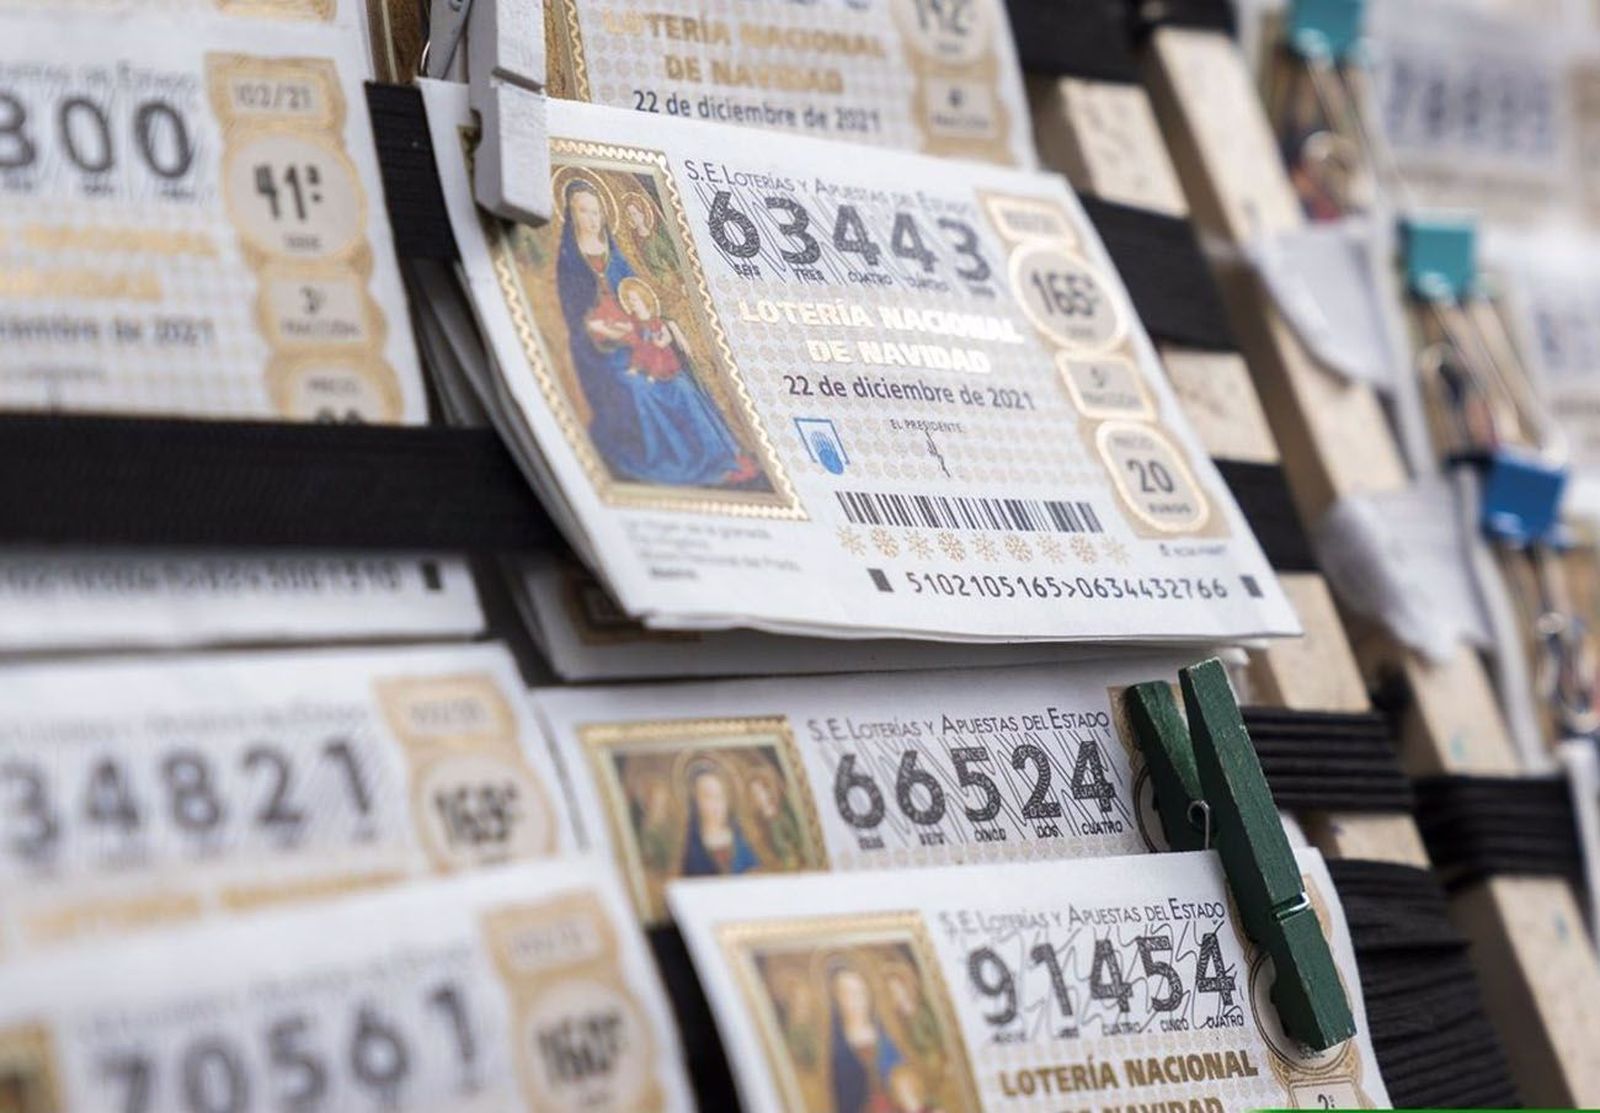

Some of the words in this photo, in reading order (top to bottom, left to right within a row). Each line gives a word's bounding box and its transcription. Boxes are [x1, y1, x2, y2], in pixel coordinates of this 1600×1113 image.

[663, 54, 701, 83] DE
[633, 90, 660, 114] 22
[666, 94, 691, 117] de
[697, 96, 797, 127] diciembre
[804, 108, 828, 131] de
[707, 189, 992, 284] 63443
[738, 299, 873, 329] LOTERÍA
[877, 305, 1024, 345] NACIONAL
[805, 339, 853, 364] DE
[857, 341, 992, 375] NAVIDAD
[783, 375, 814, 397] 22
[818, 375, 847, 399] de
[852, 377, 954, 405] diciembre
[959, 386, 984, 407] de
[988, 387, 1036, 411] 2021
[890, 419, 903, 430] EL
[906, 420, 963, 434] PRESIDENTE
[1127, 459, 1175, 494] 20
[906, 570, 1228, 599] 5102105165>0634432766
[848, 715, 922, 741] LOTERÍAS
[925, 720, 934, 737] Y
[942, 713, 1019, 736] APUESTAS
[1024, 715, 1048, 732] DEL
[1047, 707, 1110, 730] ESTADO
[833, 740, 1117, 830] 66524
[1037, 825, 1059, 839] DOS
[1081, 821, 1123, 836] CUATRO
[1068, 903, 1142, 925] APUESTAS
[1145, 904, 1170, 922] DEL
[1168, 897, 1226, 920] ESTADO
[967, 931, 1237, 1026] 91454
[1206, 1013, 1244, 1030] CUATRO
[1001, 1053, 1119, 1097] LOTERÍA
[1125, 1050, 1259, 1088] NACIONAL
